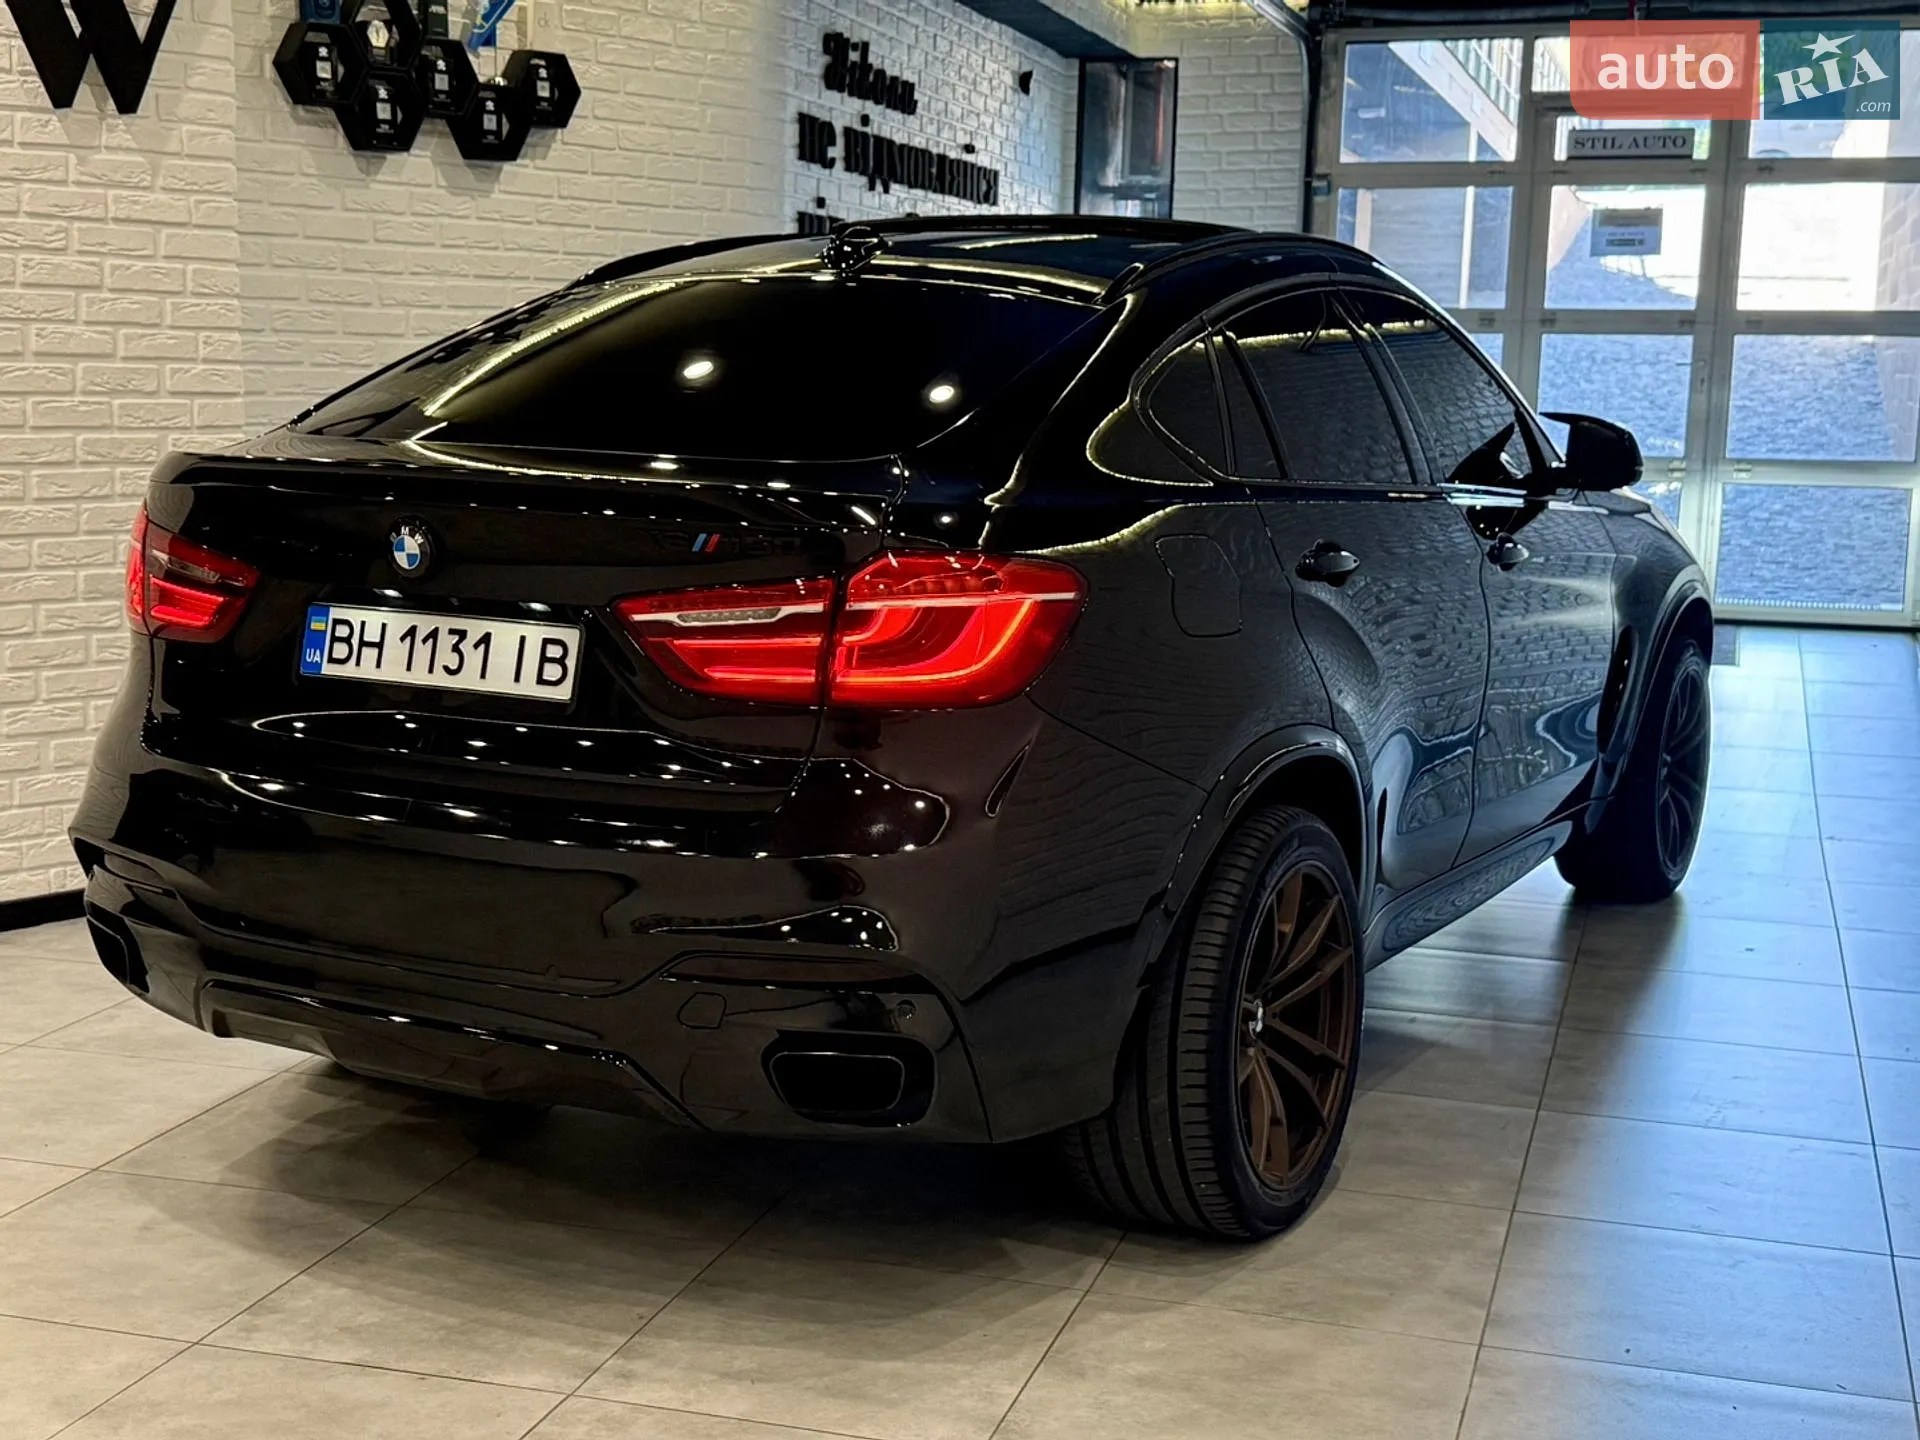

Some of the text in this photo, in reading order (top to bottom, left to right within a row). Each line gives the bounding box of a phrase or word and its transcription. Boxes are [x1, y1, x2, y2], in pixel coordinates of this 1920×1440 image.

[797, 112, 836, 169] не
[1573, 135, 1687, 150] STIL AUTO
[306, 648, 321, 665] UA
[326, 618, 569, 687] BH 1131 IB
